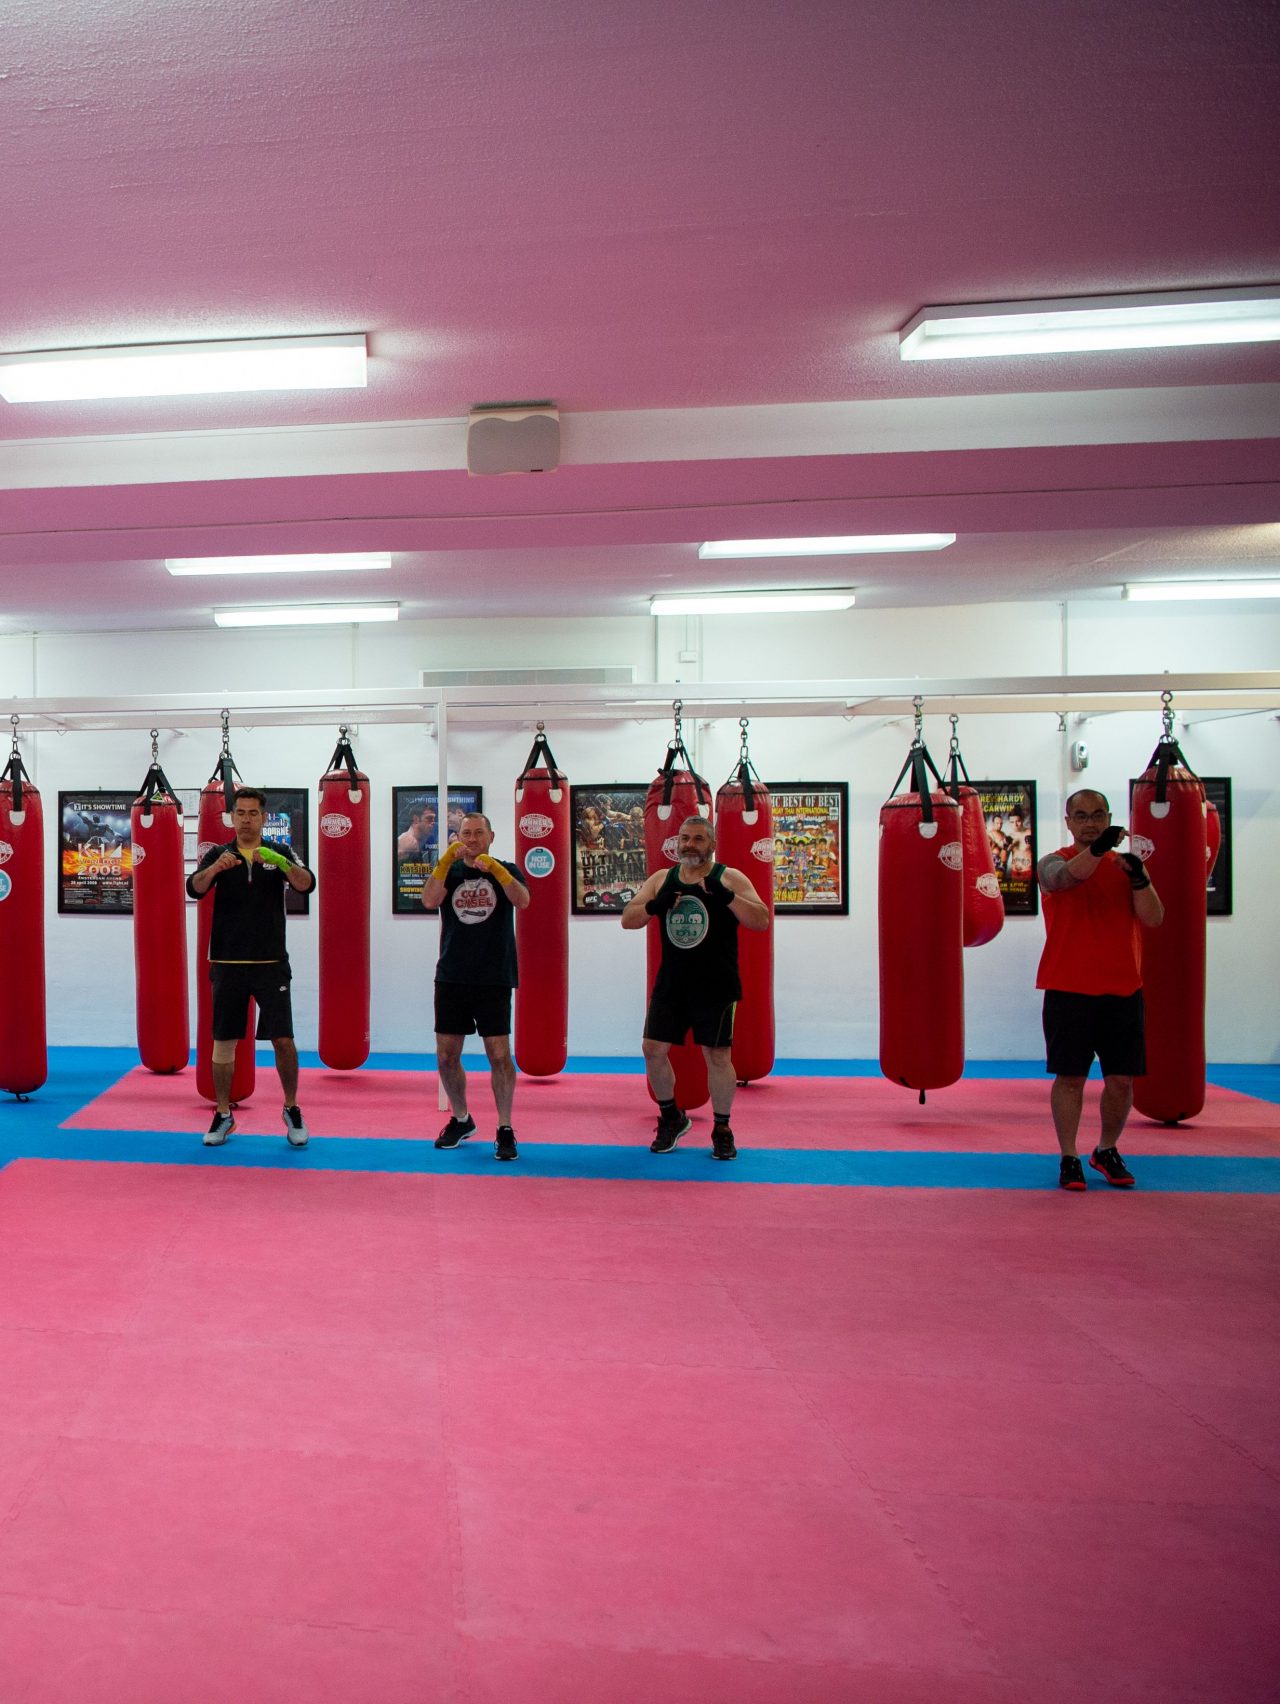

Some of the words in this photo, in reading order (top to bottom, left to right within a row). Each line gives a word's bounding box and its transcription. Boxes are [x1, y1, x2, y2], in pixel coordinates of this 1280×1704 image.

[783, 796, 803, 808] BEST
[806, 796, 816, 808] OF
[819, 796, 839, 808] BEST
[984, 805, 1015, 813] CARWIN
[262, 827, 289, 836] BOURNE
[581, 851, 646, 867] ULTIMAT
[78, 864, 122, 876] 2008
[583, 865, 647, 879] FIGHTIN
